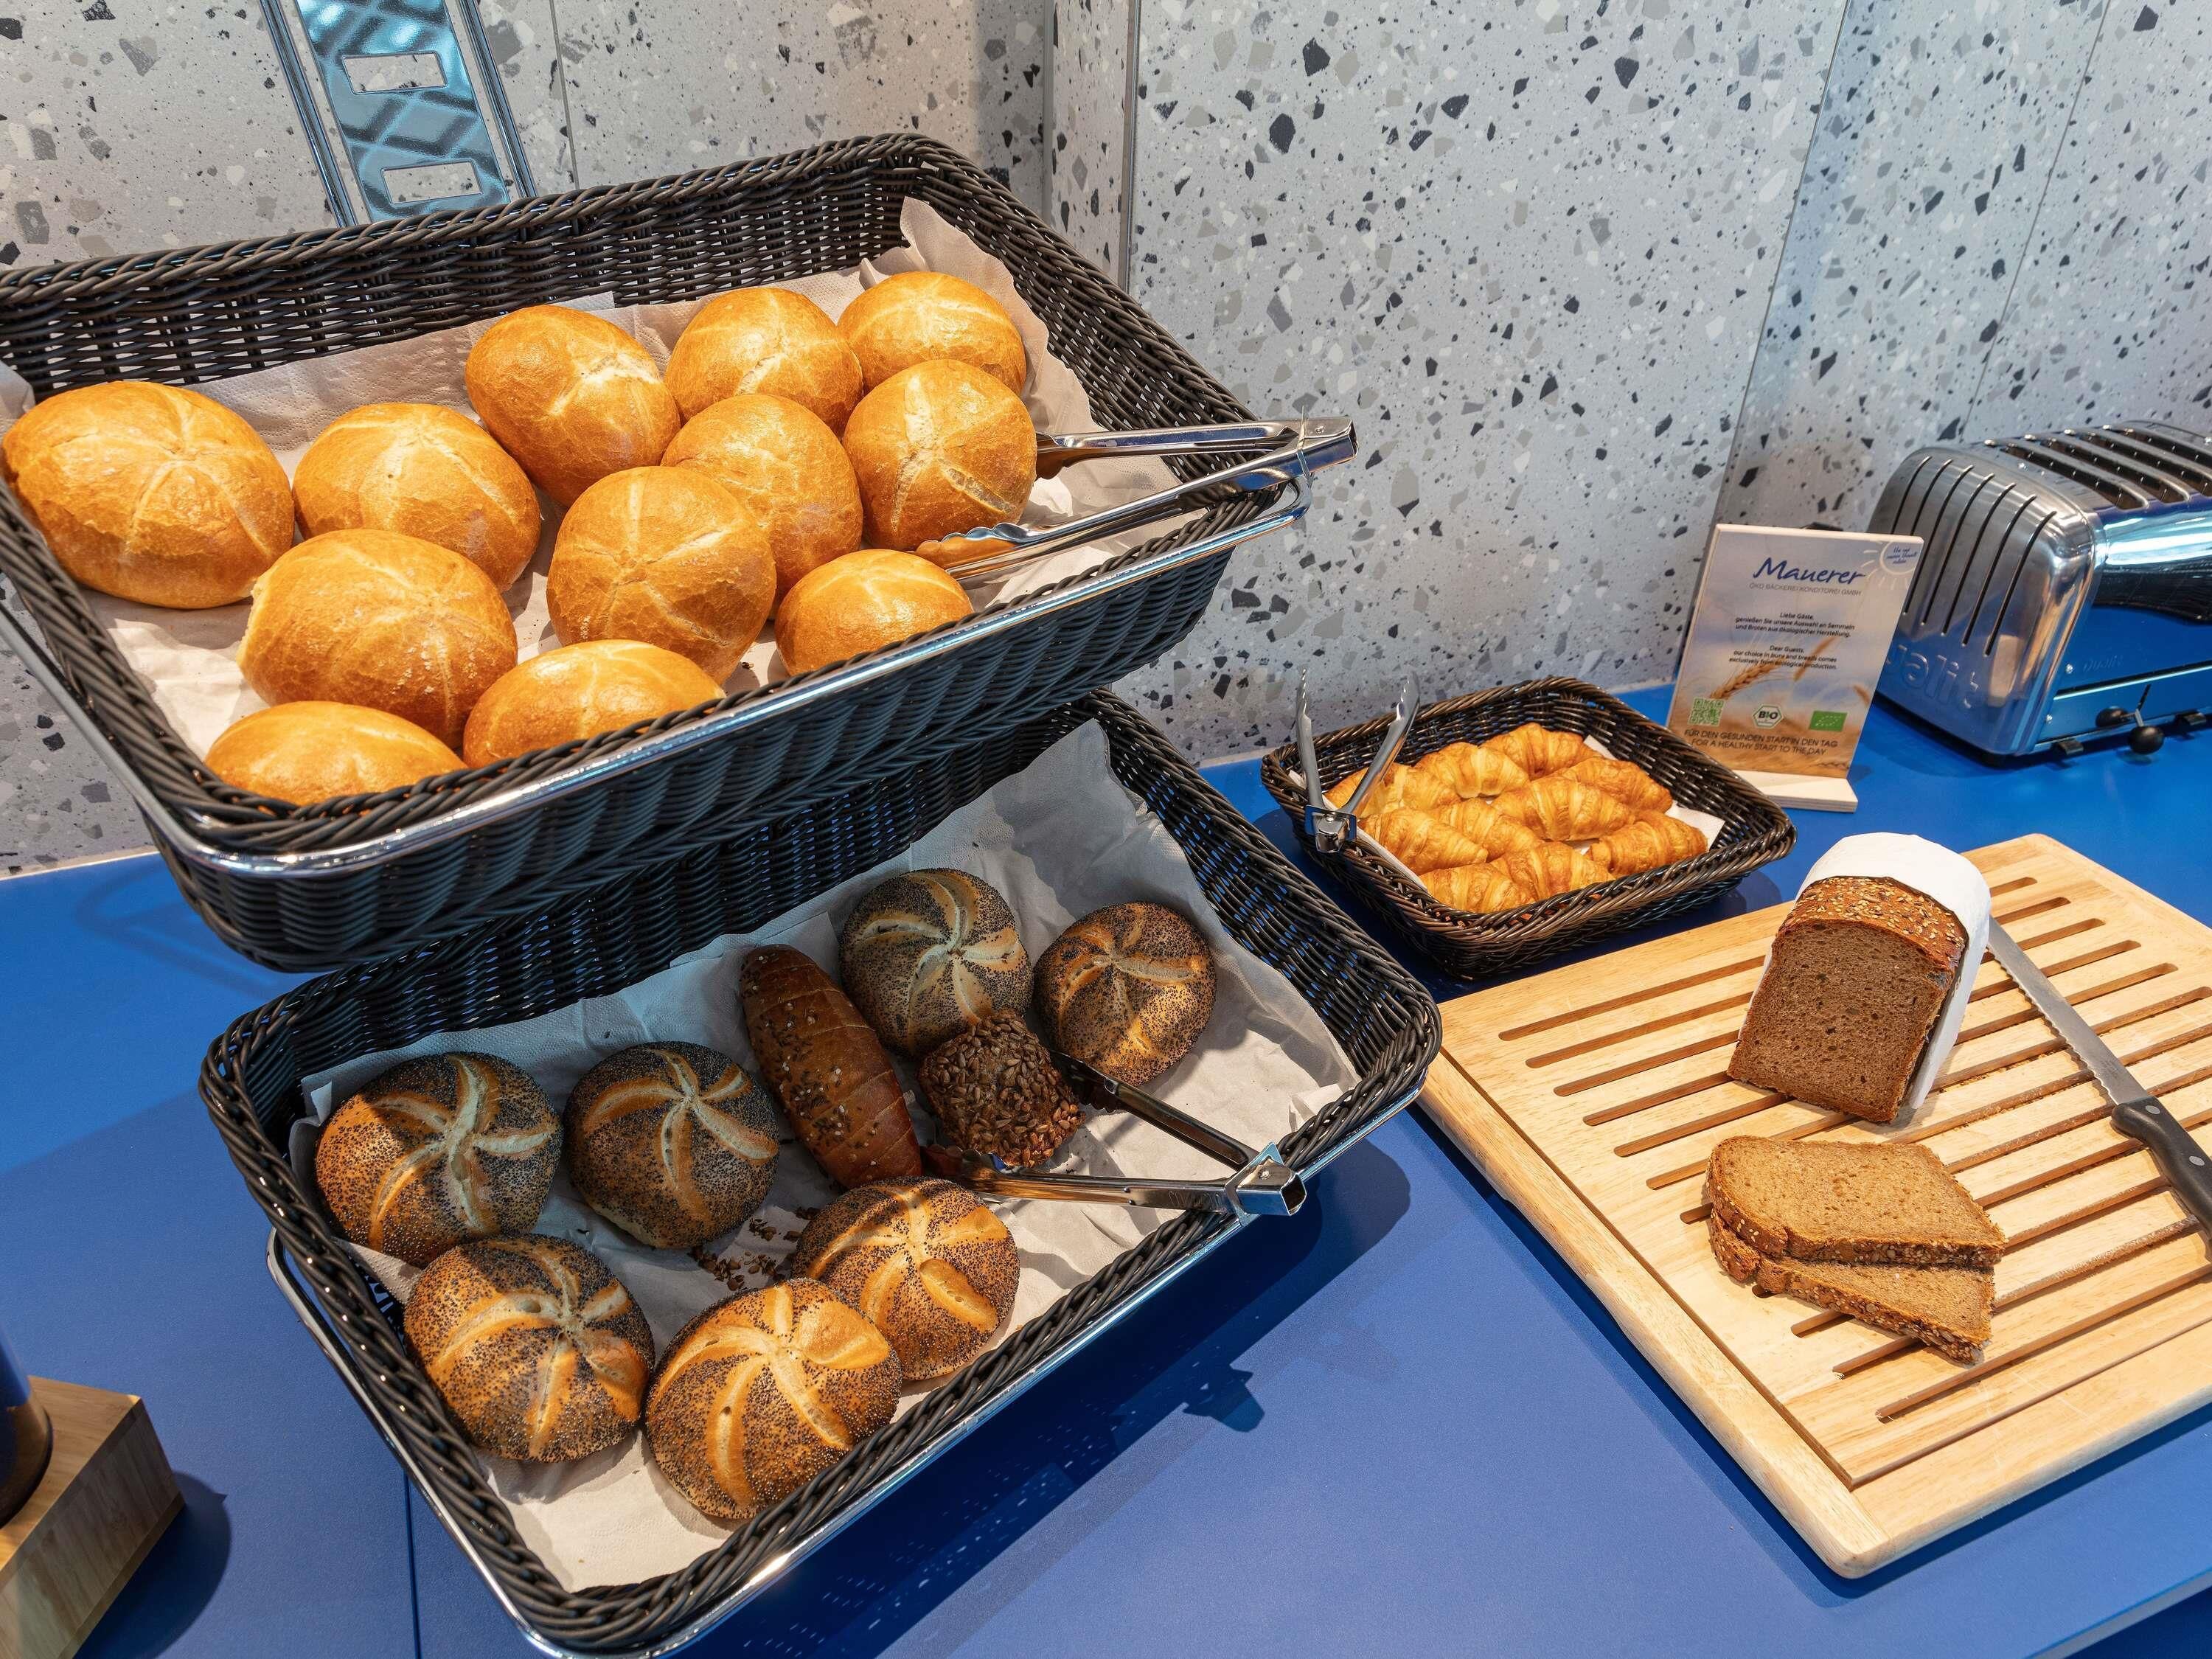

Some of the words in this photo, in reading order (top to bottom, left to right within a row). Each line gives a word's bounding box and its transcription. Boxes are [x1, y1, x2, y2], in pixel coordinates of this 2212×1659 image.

[1753, 557, 1865, 585] Mauerer
[1729, 658, 1759, 666] exclusively
[1691, 738, 1708, 746] FOR
[1718, 740, 1753, 749] HEALTHY
[1754, 742, 1777, 751] START
[1780, 745, 1790, 753] TO
[1792, 746, 1806, 754] THE
[1806, 748, 1826, 756] DAY
[1701, 730, 1719, 738] DEN
[1720, 731, 1765, 742] GESUNDEN
[1766, 735, 1790, 744] START
[1801, 737, 1819, 746] DEN
[1820, 740, 1838, 748] TAG
